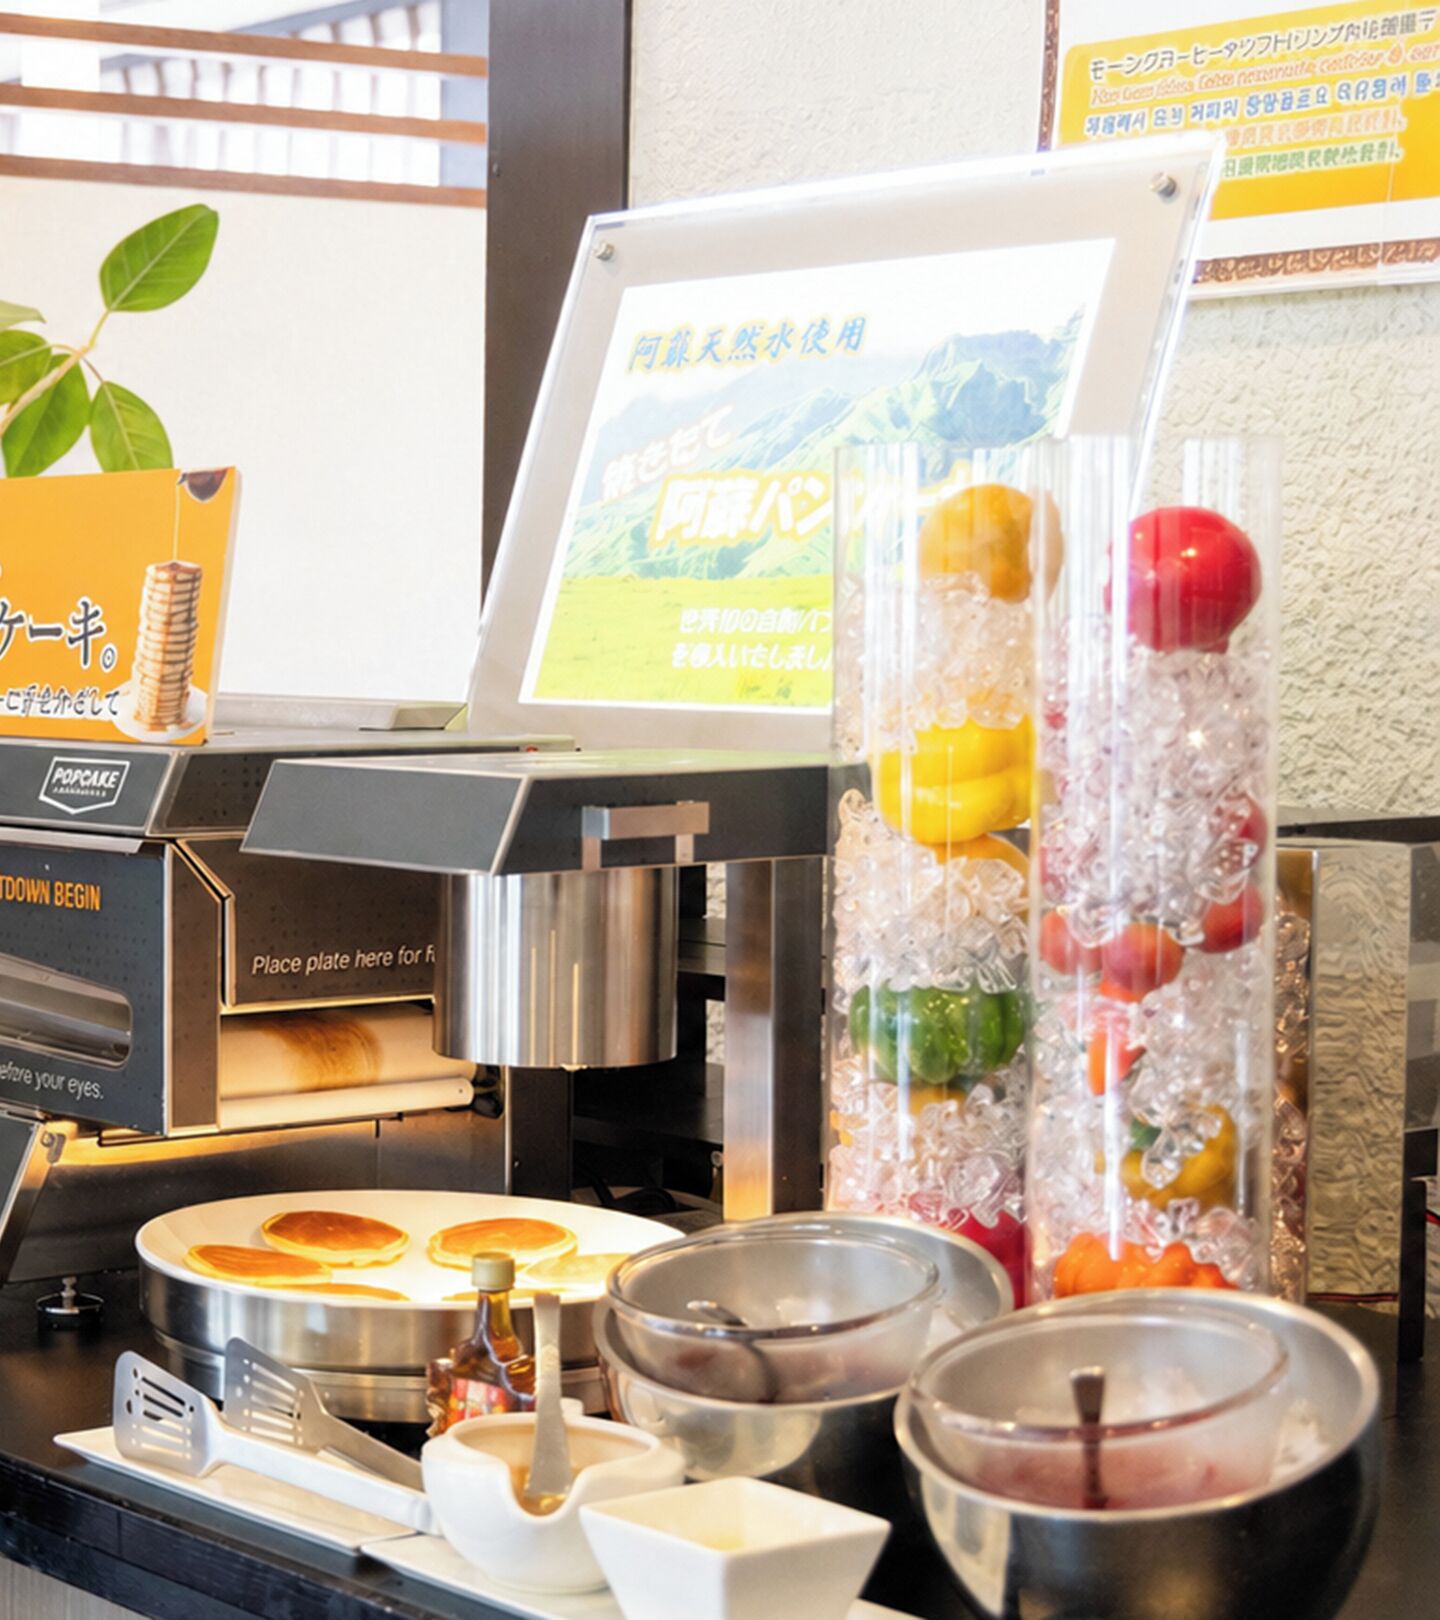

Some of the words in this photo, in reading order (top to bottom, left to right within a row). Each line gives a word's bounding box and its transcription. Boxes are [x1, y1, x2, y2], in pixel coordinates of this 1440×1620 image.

[51, 766, 120, 789] POPCAKE
[54, 881, 101, 912] BEGIN
[251, 955, 302, 975] Place
[305, 951, 350, 976] plate
[354, 948, 393, 968] here
[397, 945, 422, 965] for
[34, 1071, 65, 1091] your
[67, 1077, 104, 1100] eyes.
